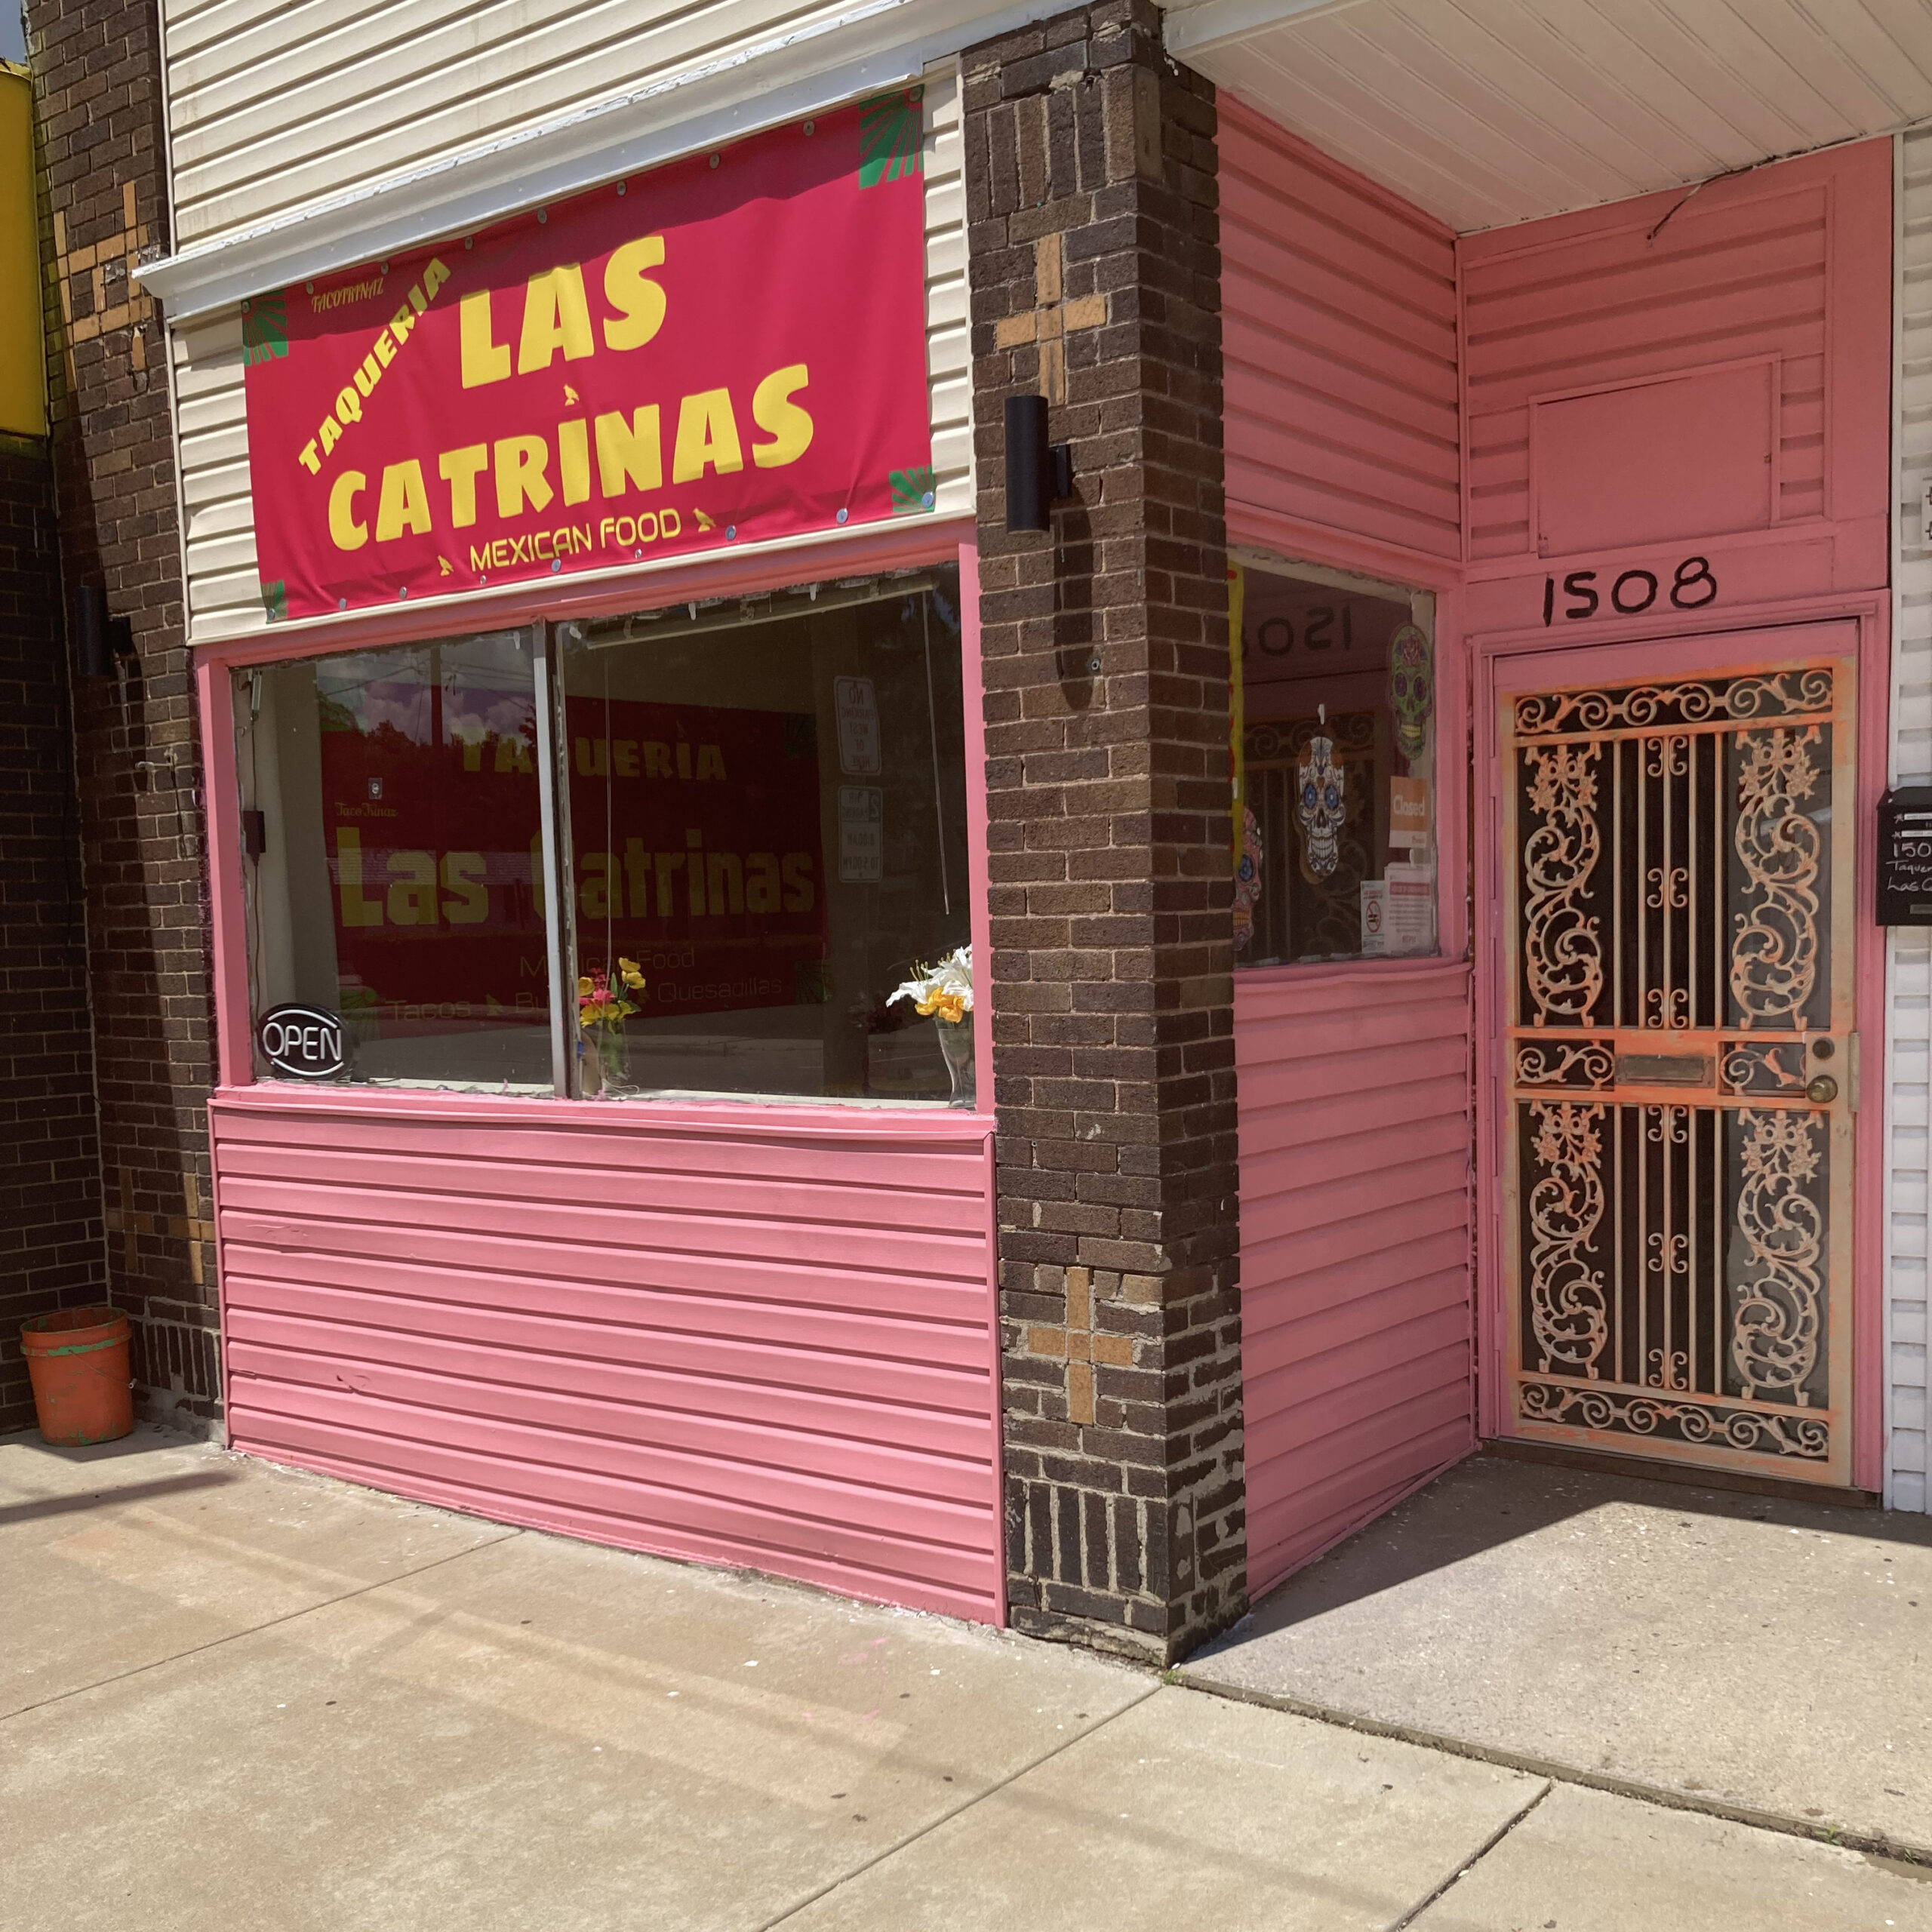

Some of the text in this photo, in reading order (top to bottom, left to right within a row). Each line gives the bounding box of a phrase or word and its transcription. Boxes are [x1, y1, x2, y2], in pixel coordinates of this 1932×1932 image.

[460, 235, 667, 389] LAS
[297, 257, 452, 476] TAQUERIA
[328, 363, 814, 552] CATRINAS
[469, 508, 682, 572] MEXICAN FOOD
[1543, 556, 1717, 628] 1508
[451, 731, 727, 781] TAUERIA
[1393, 794, 1426, 817] Closed
[336, 826, 489, 927] Las
[636, 948, 695, 971] Food
[385, 977, 783, 1022] Tacos Quesadillas
[263, 1022, 342, 1061] OPEN
